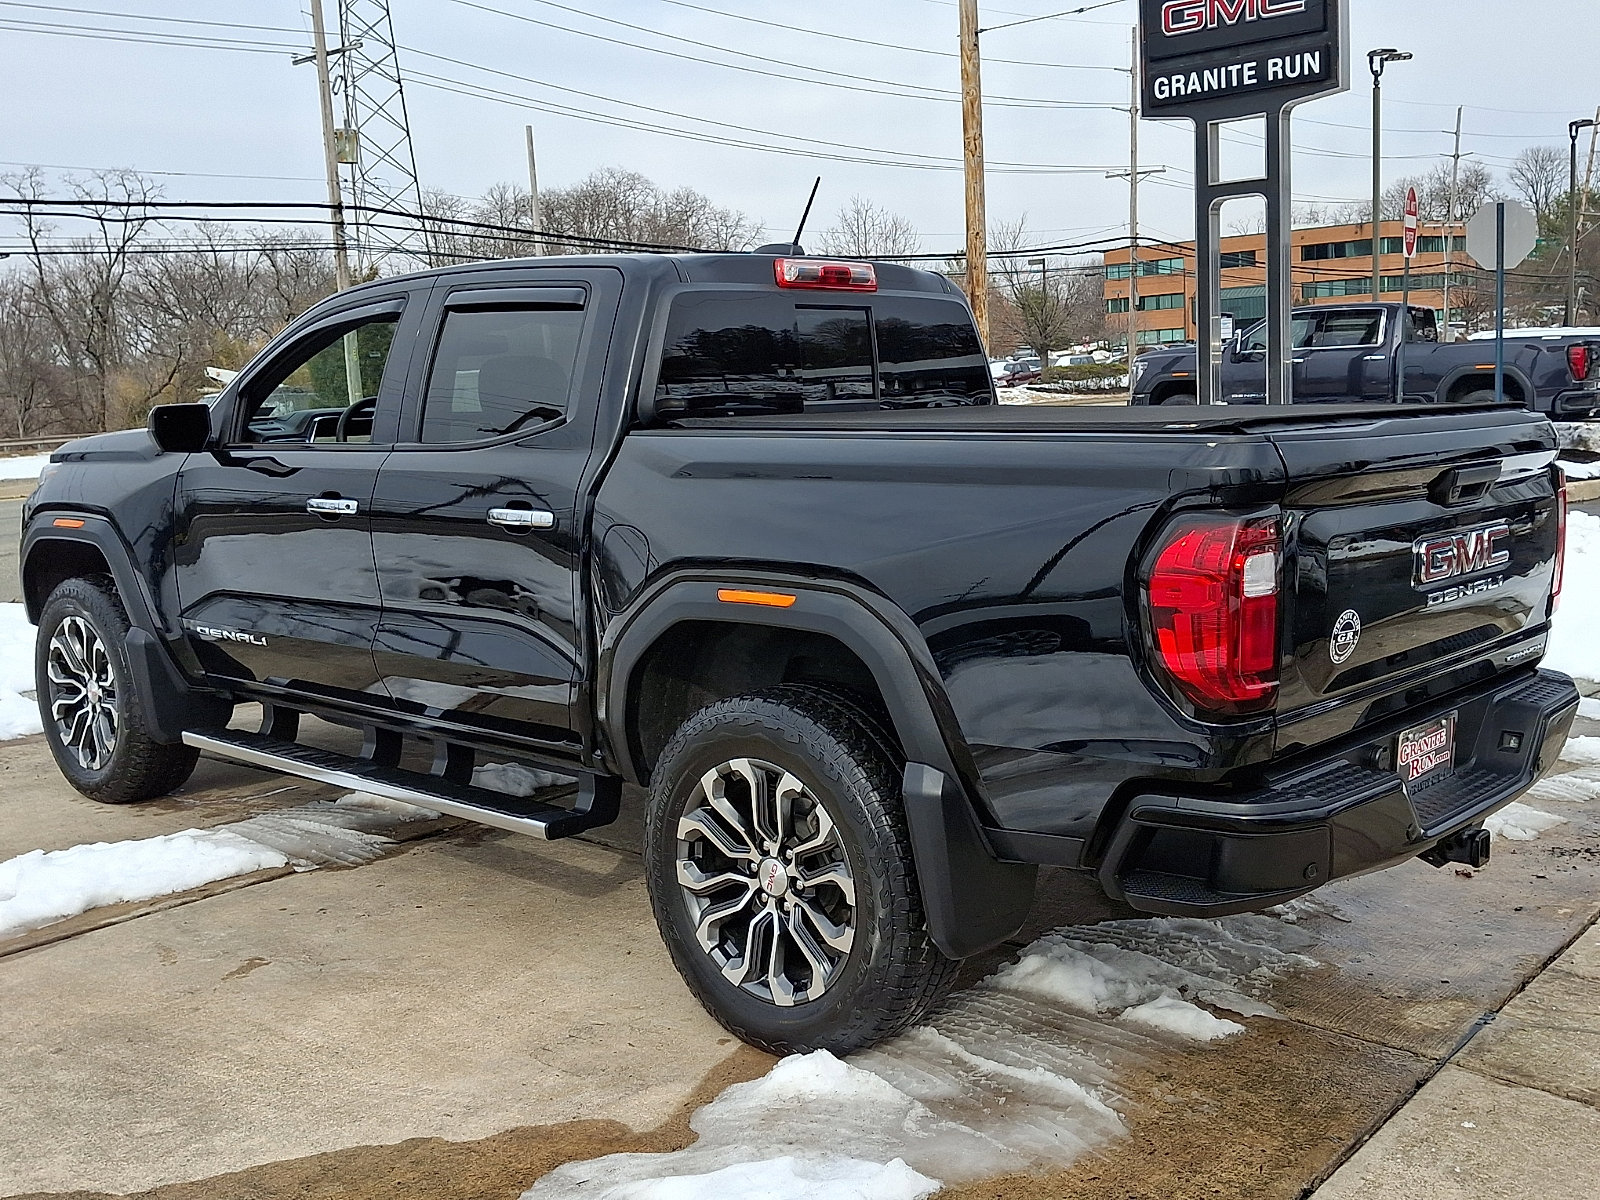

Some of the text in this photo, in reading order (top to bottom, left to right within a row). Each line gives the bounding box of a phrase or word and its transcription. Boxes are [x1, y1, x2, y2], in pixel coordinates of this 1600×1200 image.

[1154, 51, 1320, 99] GRANITE RUN
[1422, 525, 1510, 583] GMC
[1426, 574, 1503, 607] DENALI
[196, 626, 269, 647] DENALI
[1337, 631, 1354, 642] GR
[1400, 728, 1447, 765] GRANITE
[766, 863, 778, 892] GMC
